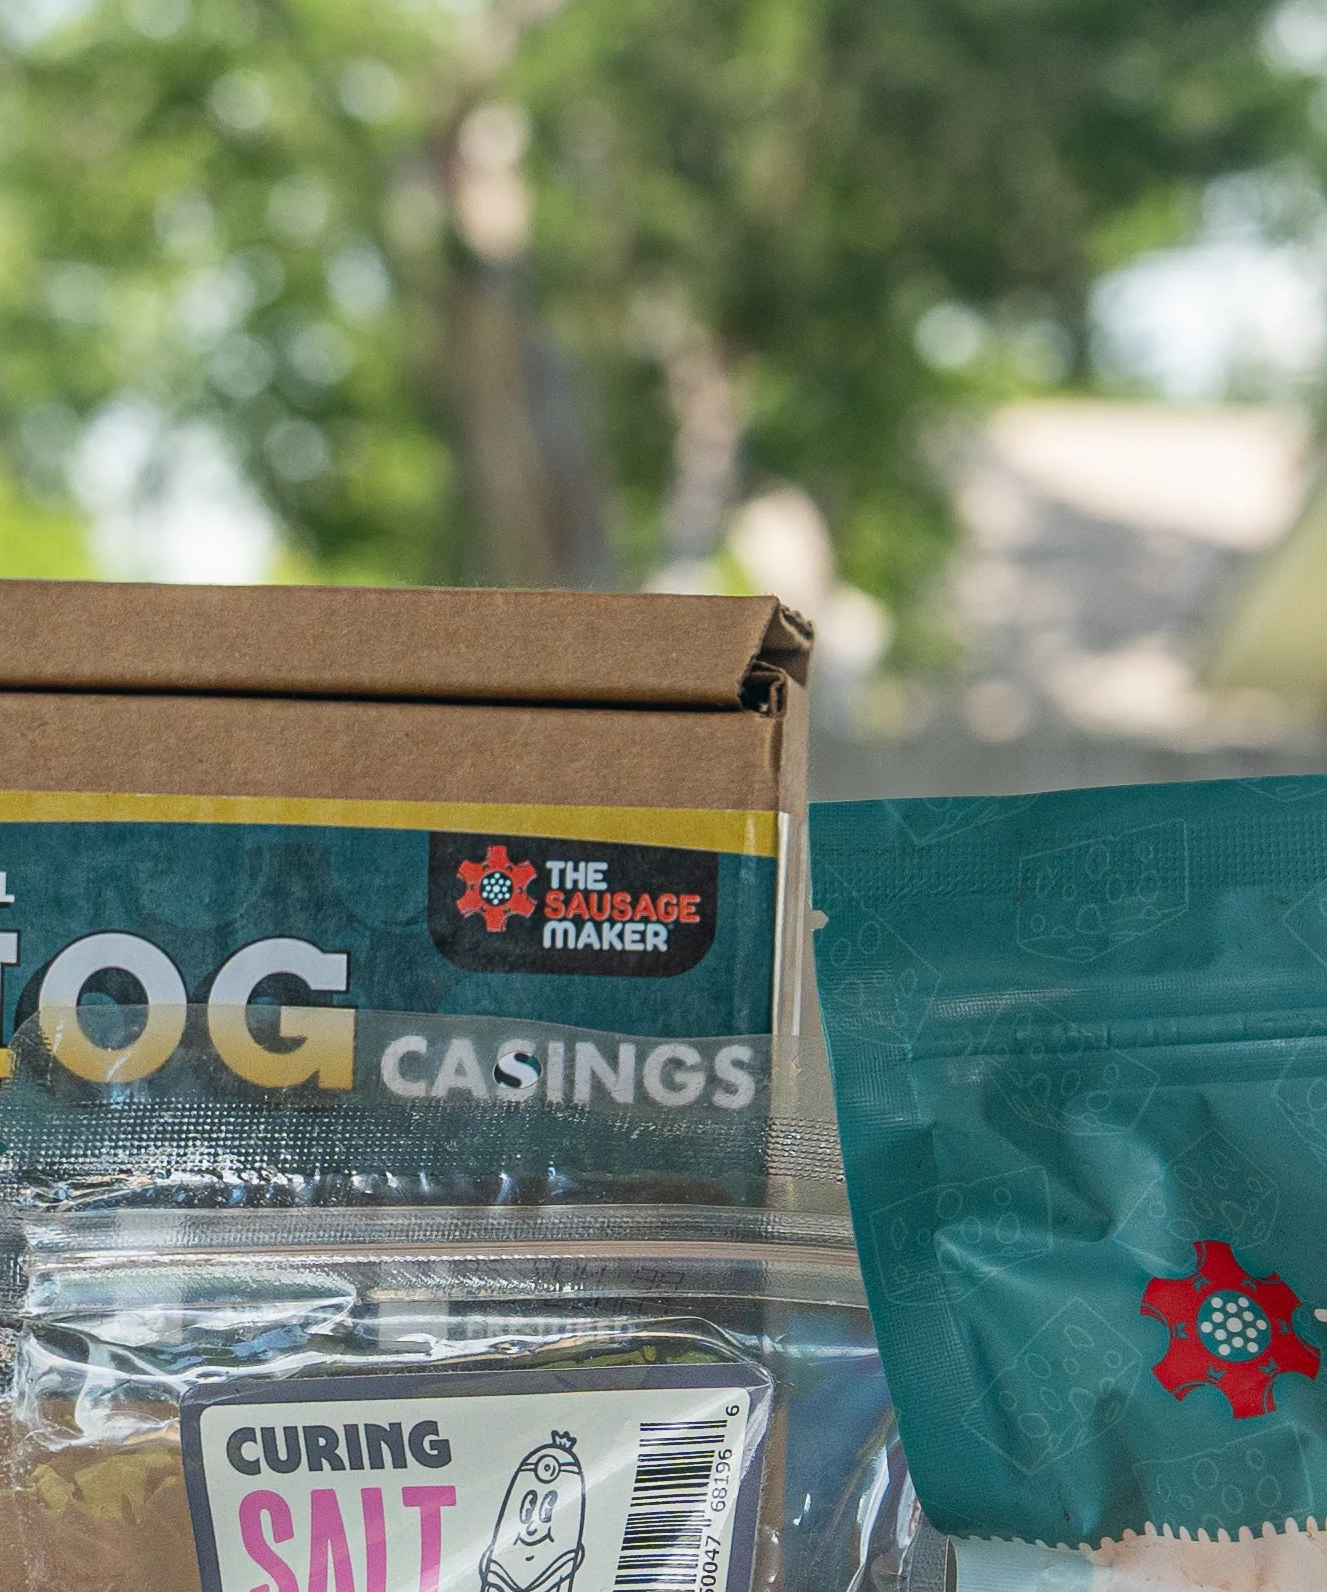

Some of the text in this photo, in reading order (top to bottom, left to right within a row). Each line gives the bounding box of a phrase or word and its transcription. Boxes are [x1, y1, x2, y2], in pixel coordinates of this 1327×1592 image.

[546, 861, 608, 890] THE
[544, 890, 701, 922] SAUSAGE
[543, 921, 668, 951] MAKER
[380, 1034, 756, 1110] CASINGS
[226, 1420, 452, 1476] CURING
[711, 1449, 732, 1512] 68196
